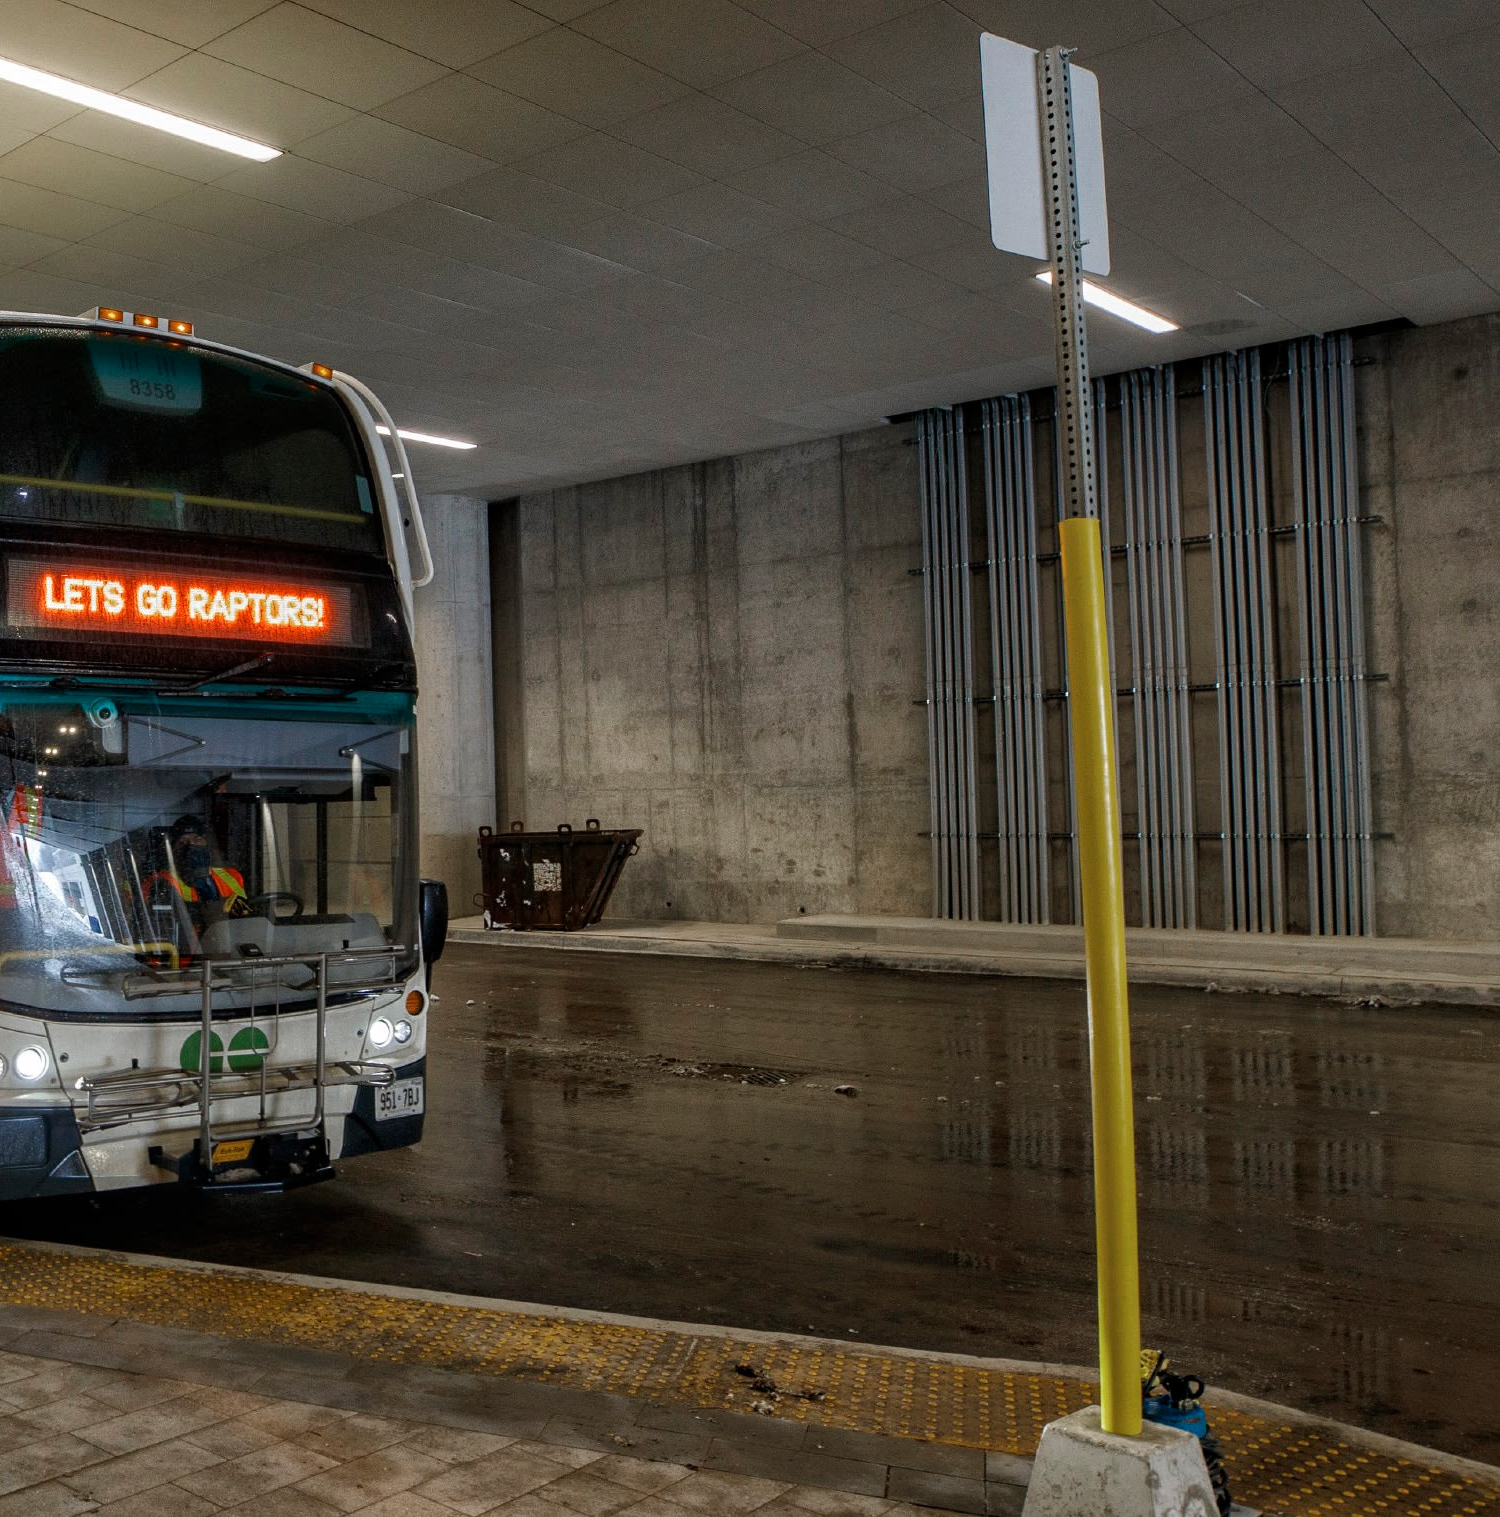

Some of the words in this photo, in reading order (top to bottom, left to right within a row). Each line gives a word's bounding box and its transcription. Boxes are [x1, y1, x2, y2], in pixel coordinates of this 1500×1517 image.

[130, 379, 176, 400] 8358
[44, 575, 125, 614] LETS
[136, 583, 178, 618] GO
[188, 586, 325, 628] RAPTORS!
